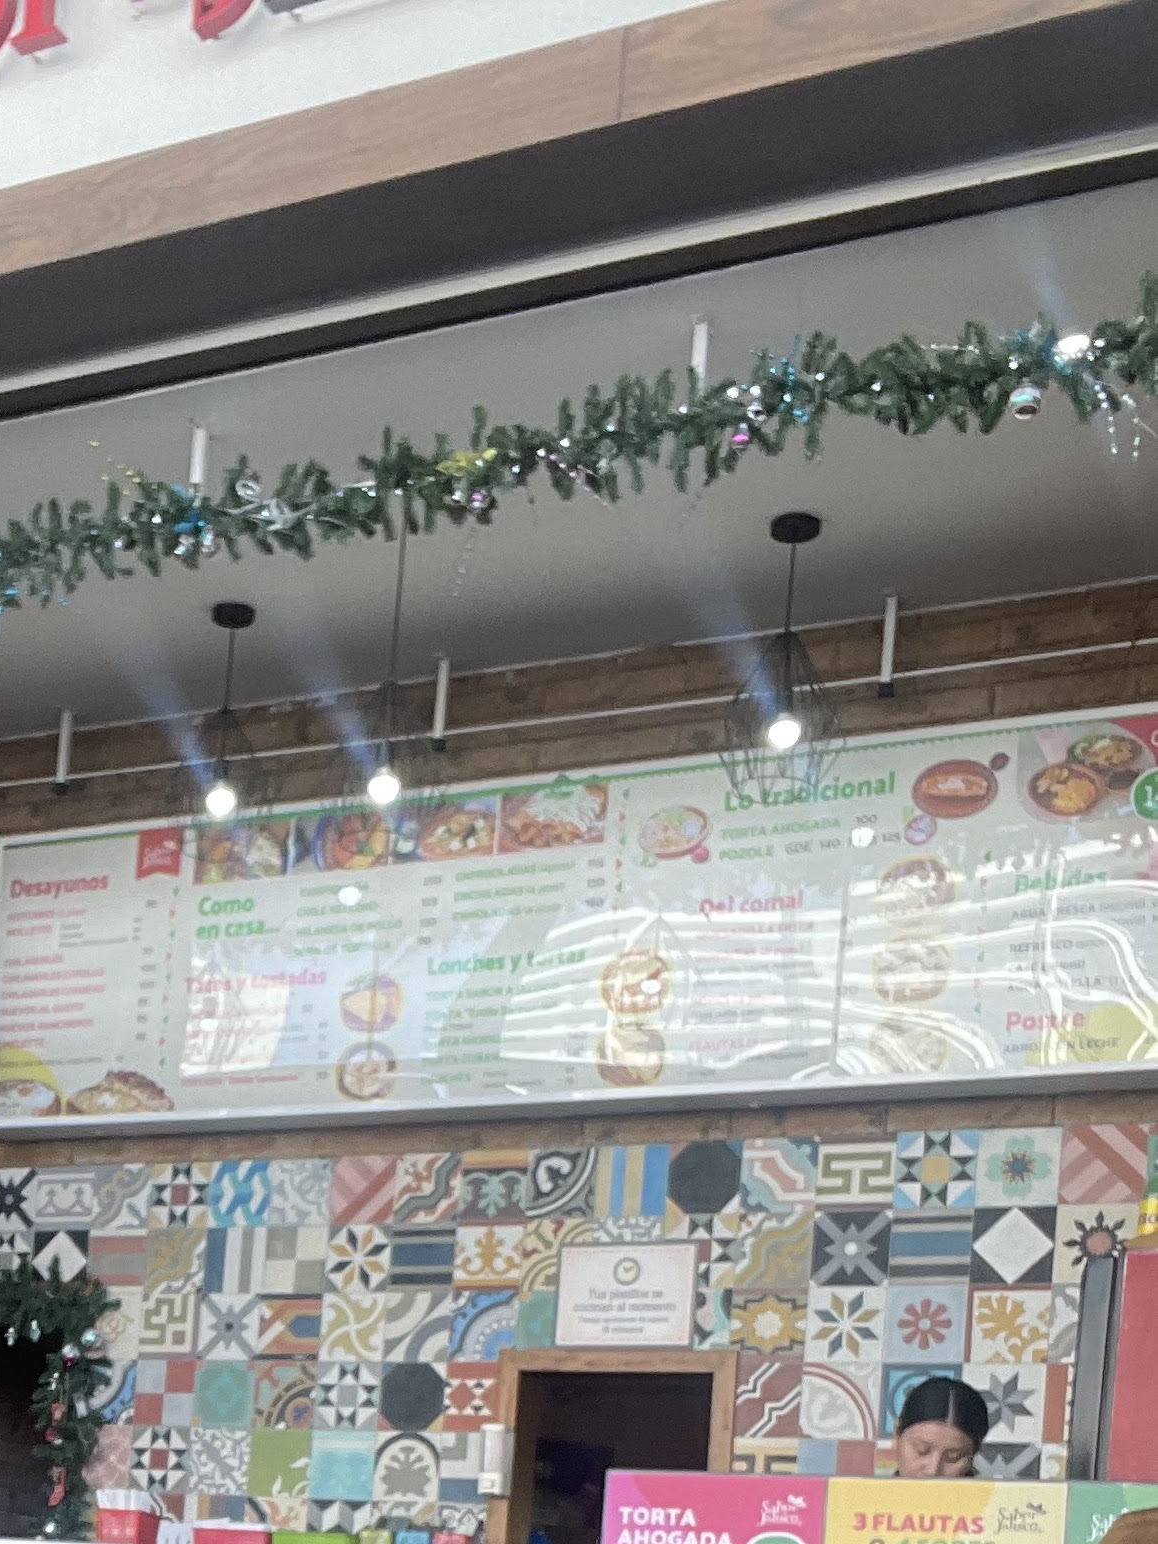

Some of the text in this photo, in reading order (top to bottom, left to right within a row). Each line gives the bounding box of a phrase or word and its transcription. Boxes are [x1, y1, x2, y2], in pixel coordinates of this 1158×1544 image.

[724, 769, 898, 812] Lo tradicional
[9, 875, 110, 900] Desayunos
[198, 895, 256, 917] Como
[738, 887, 804, 912] comal
[195, 921, 220, 939] en
[426, 953, 507, 977] Lonches
[618, 1506, 696, 1528] TORTA
[852, 1512, 985, 1535] 3 FLAUTAS
